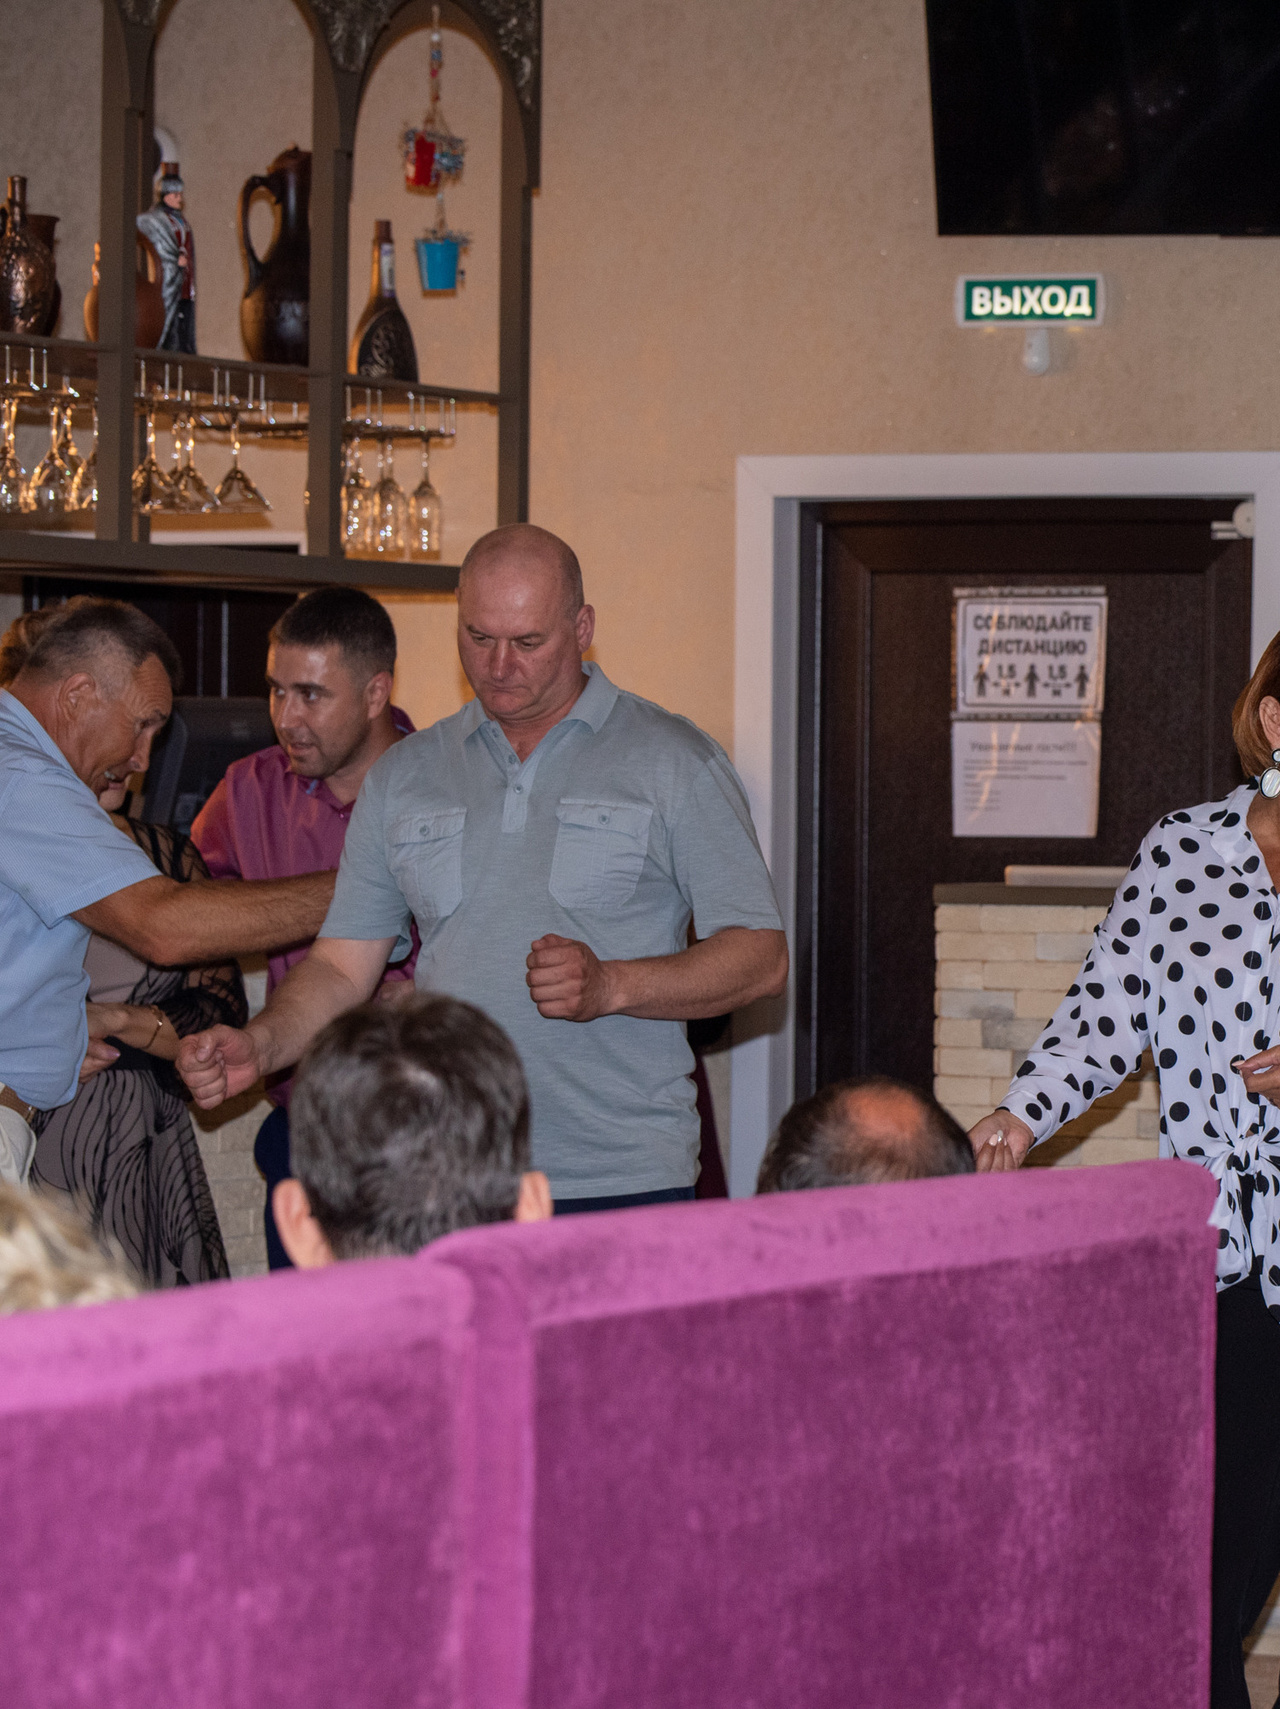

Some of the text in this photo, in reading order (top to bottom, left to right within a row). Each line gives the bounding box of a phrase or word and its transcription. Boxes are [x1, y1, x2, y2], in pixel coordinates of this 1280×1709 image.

[971, 285, 1093, 317] ВЫХОД
[973, 610, 1093, 632] СОБЛЮДАЙТЕ
[978, 638, 1087, 657] ДИСТАНЦИЮ
